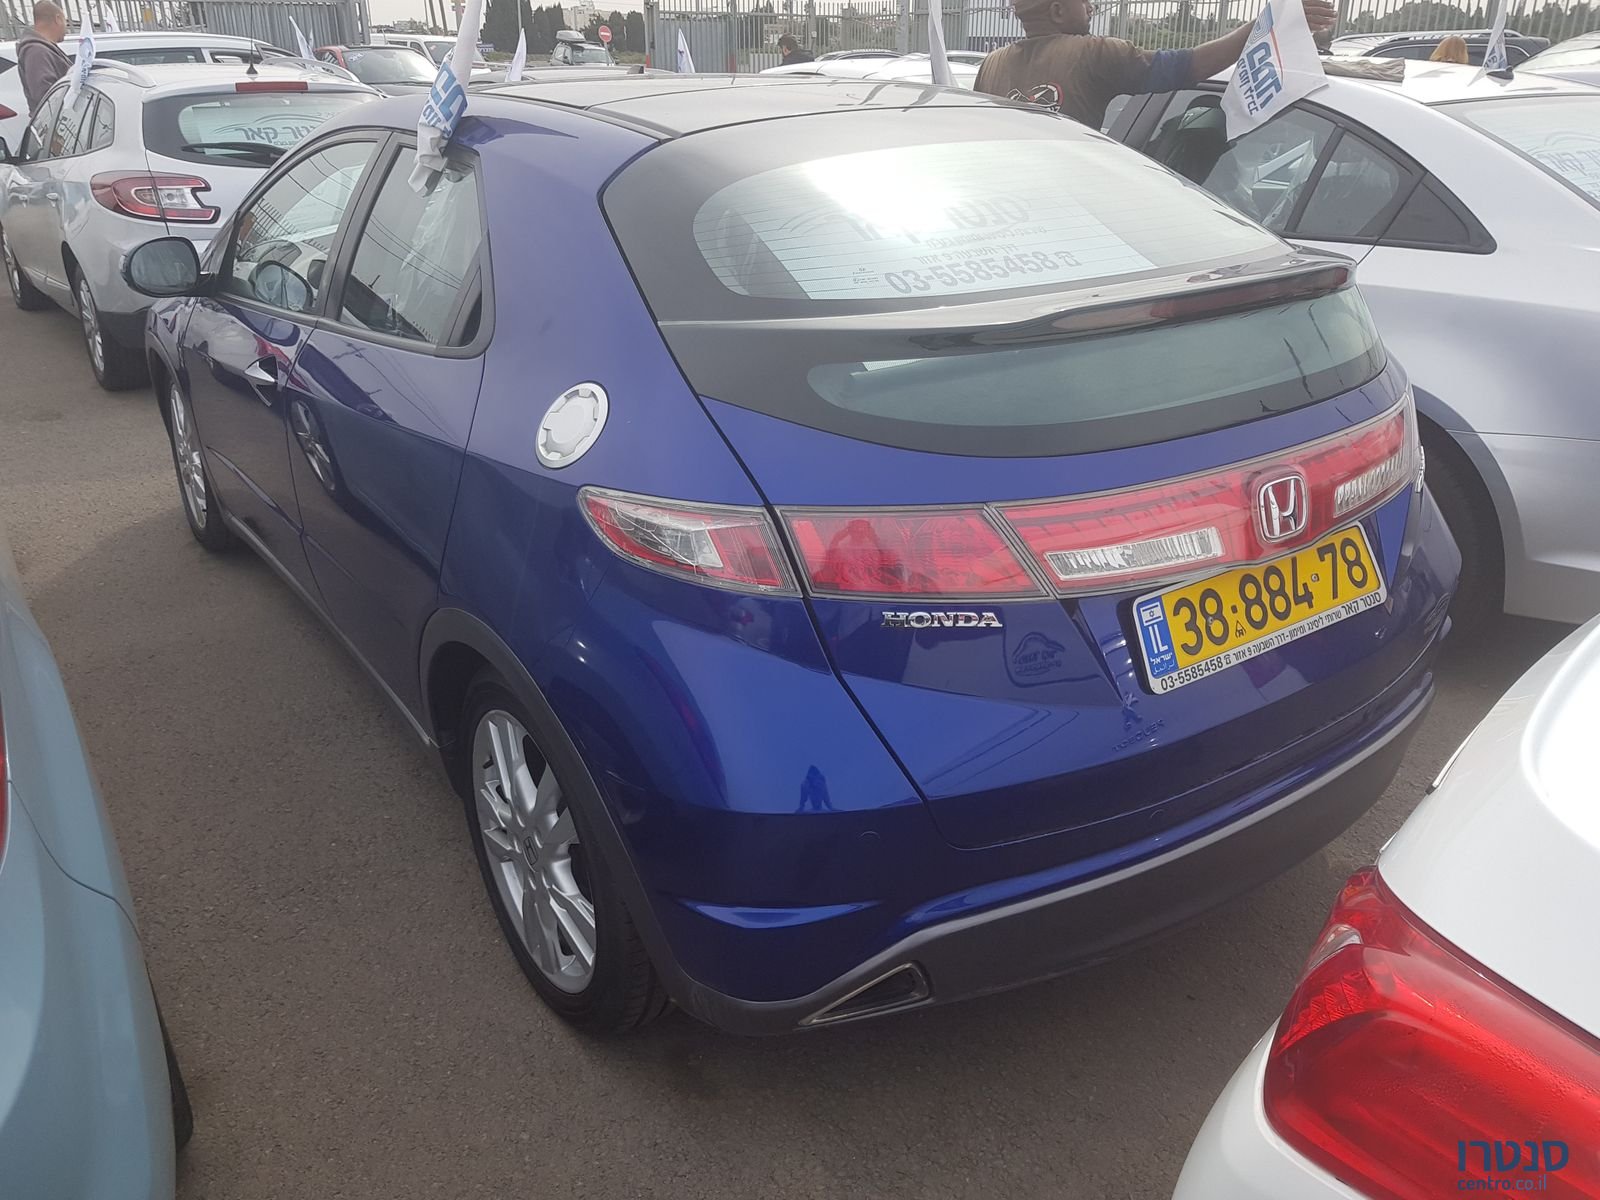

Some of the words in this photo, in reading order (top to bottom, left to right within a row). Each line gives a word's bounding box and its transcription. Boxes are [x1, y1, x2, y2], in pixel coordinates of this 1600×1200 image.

[238, 126, 279, 144] קאר
[884, 251, 1060, 294] 03-5585458
[1341, 600, 1359, 615] קאר
[1360, 591, 1382, 607] סנטר
[880, 611, 1003, 628] HONDA
[1149, 624, 1168, 654] IL
[1252, 637, 1275, 654] השבעה
[1150, 652, 1173, 666] ישראל
[1232, 649, 1247, 662] אזור
[1160, 656, 1224, 691] 03-5585458
